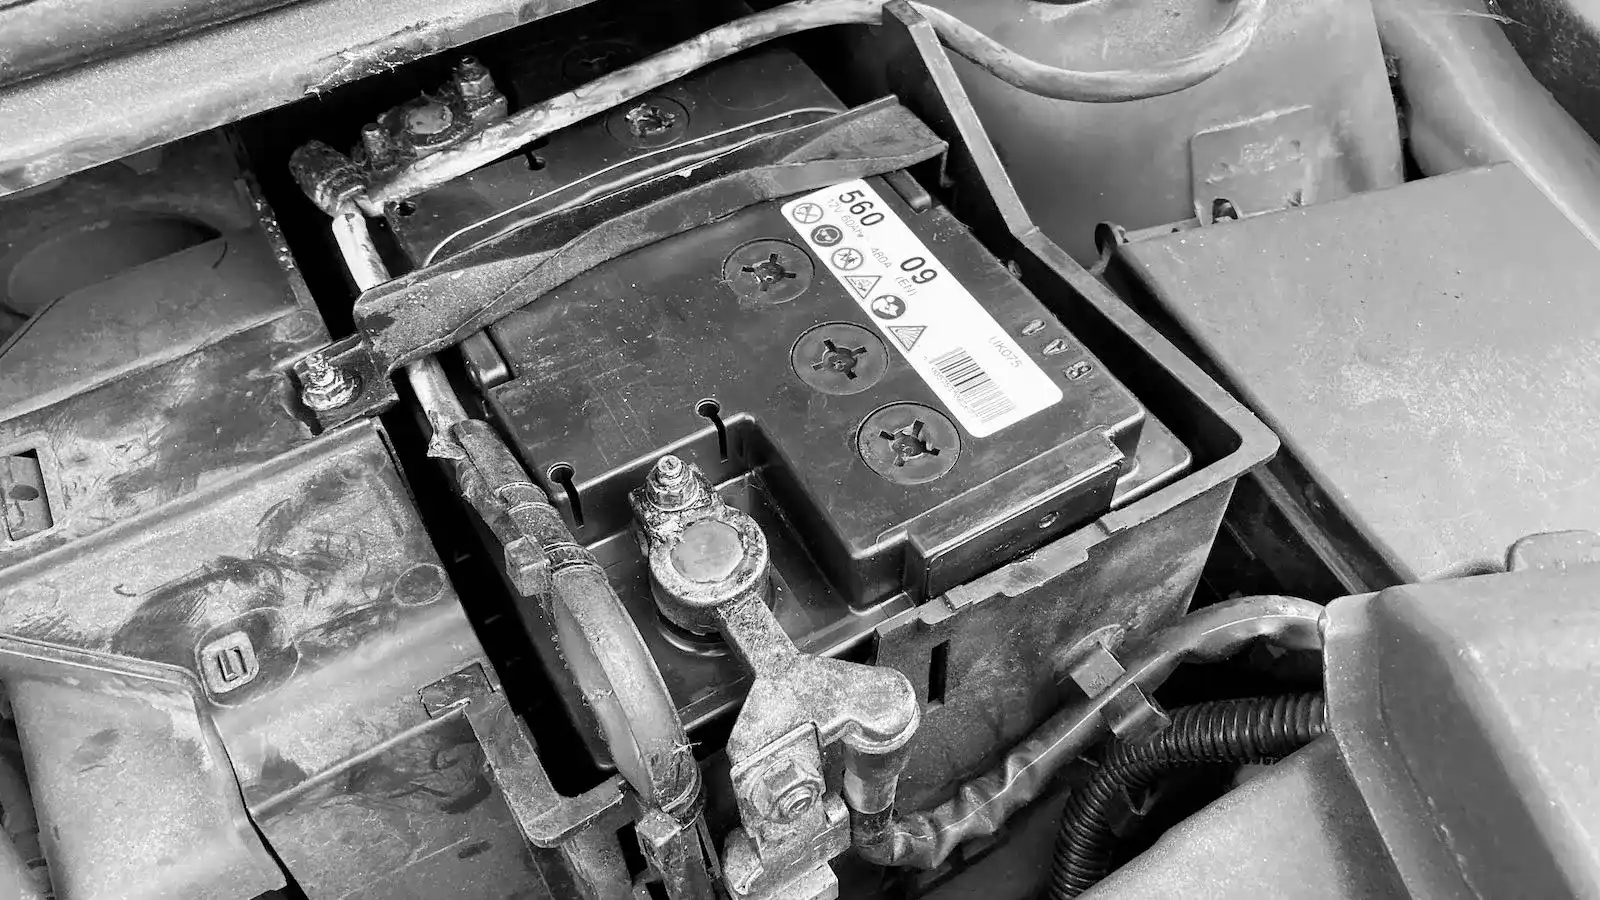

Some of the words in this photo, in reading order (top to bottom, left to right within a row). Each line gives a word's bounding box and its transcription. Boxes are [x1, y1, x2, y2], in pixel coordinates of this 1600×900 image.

[827, 199, 845, 213] 12V
[870, 247, 893, 269] 480A
[838, 189, 885, 227] 560
[900, 256, 938, 285] 09
